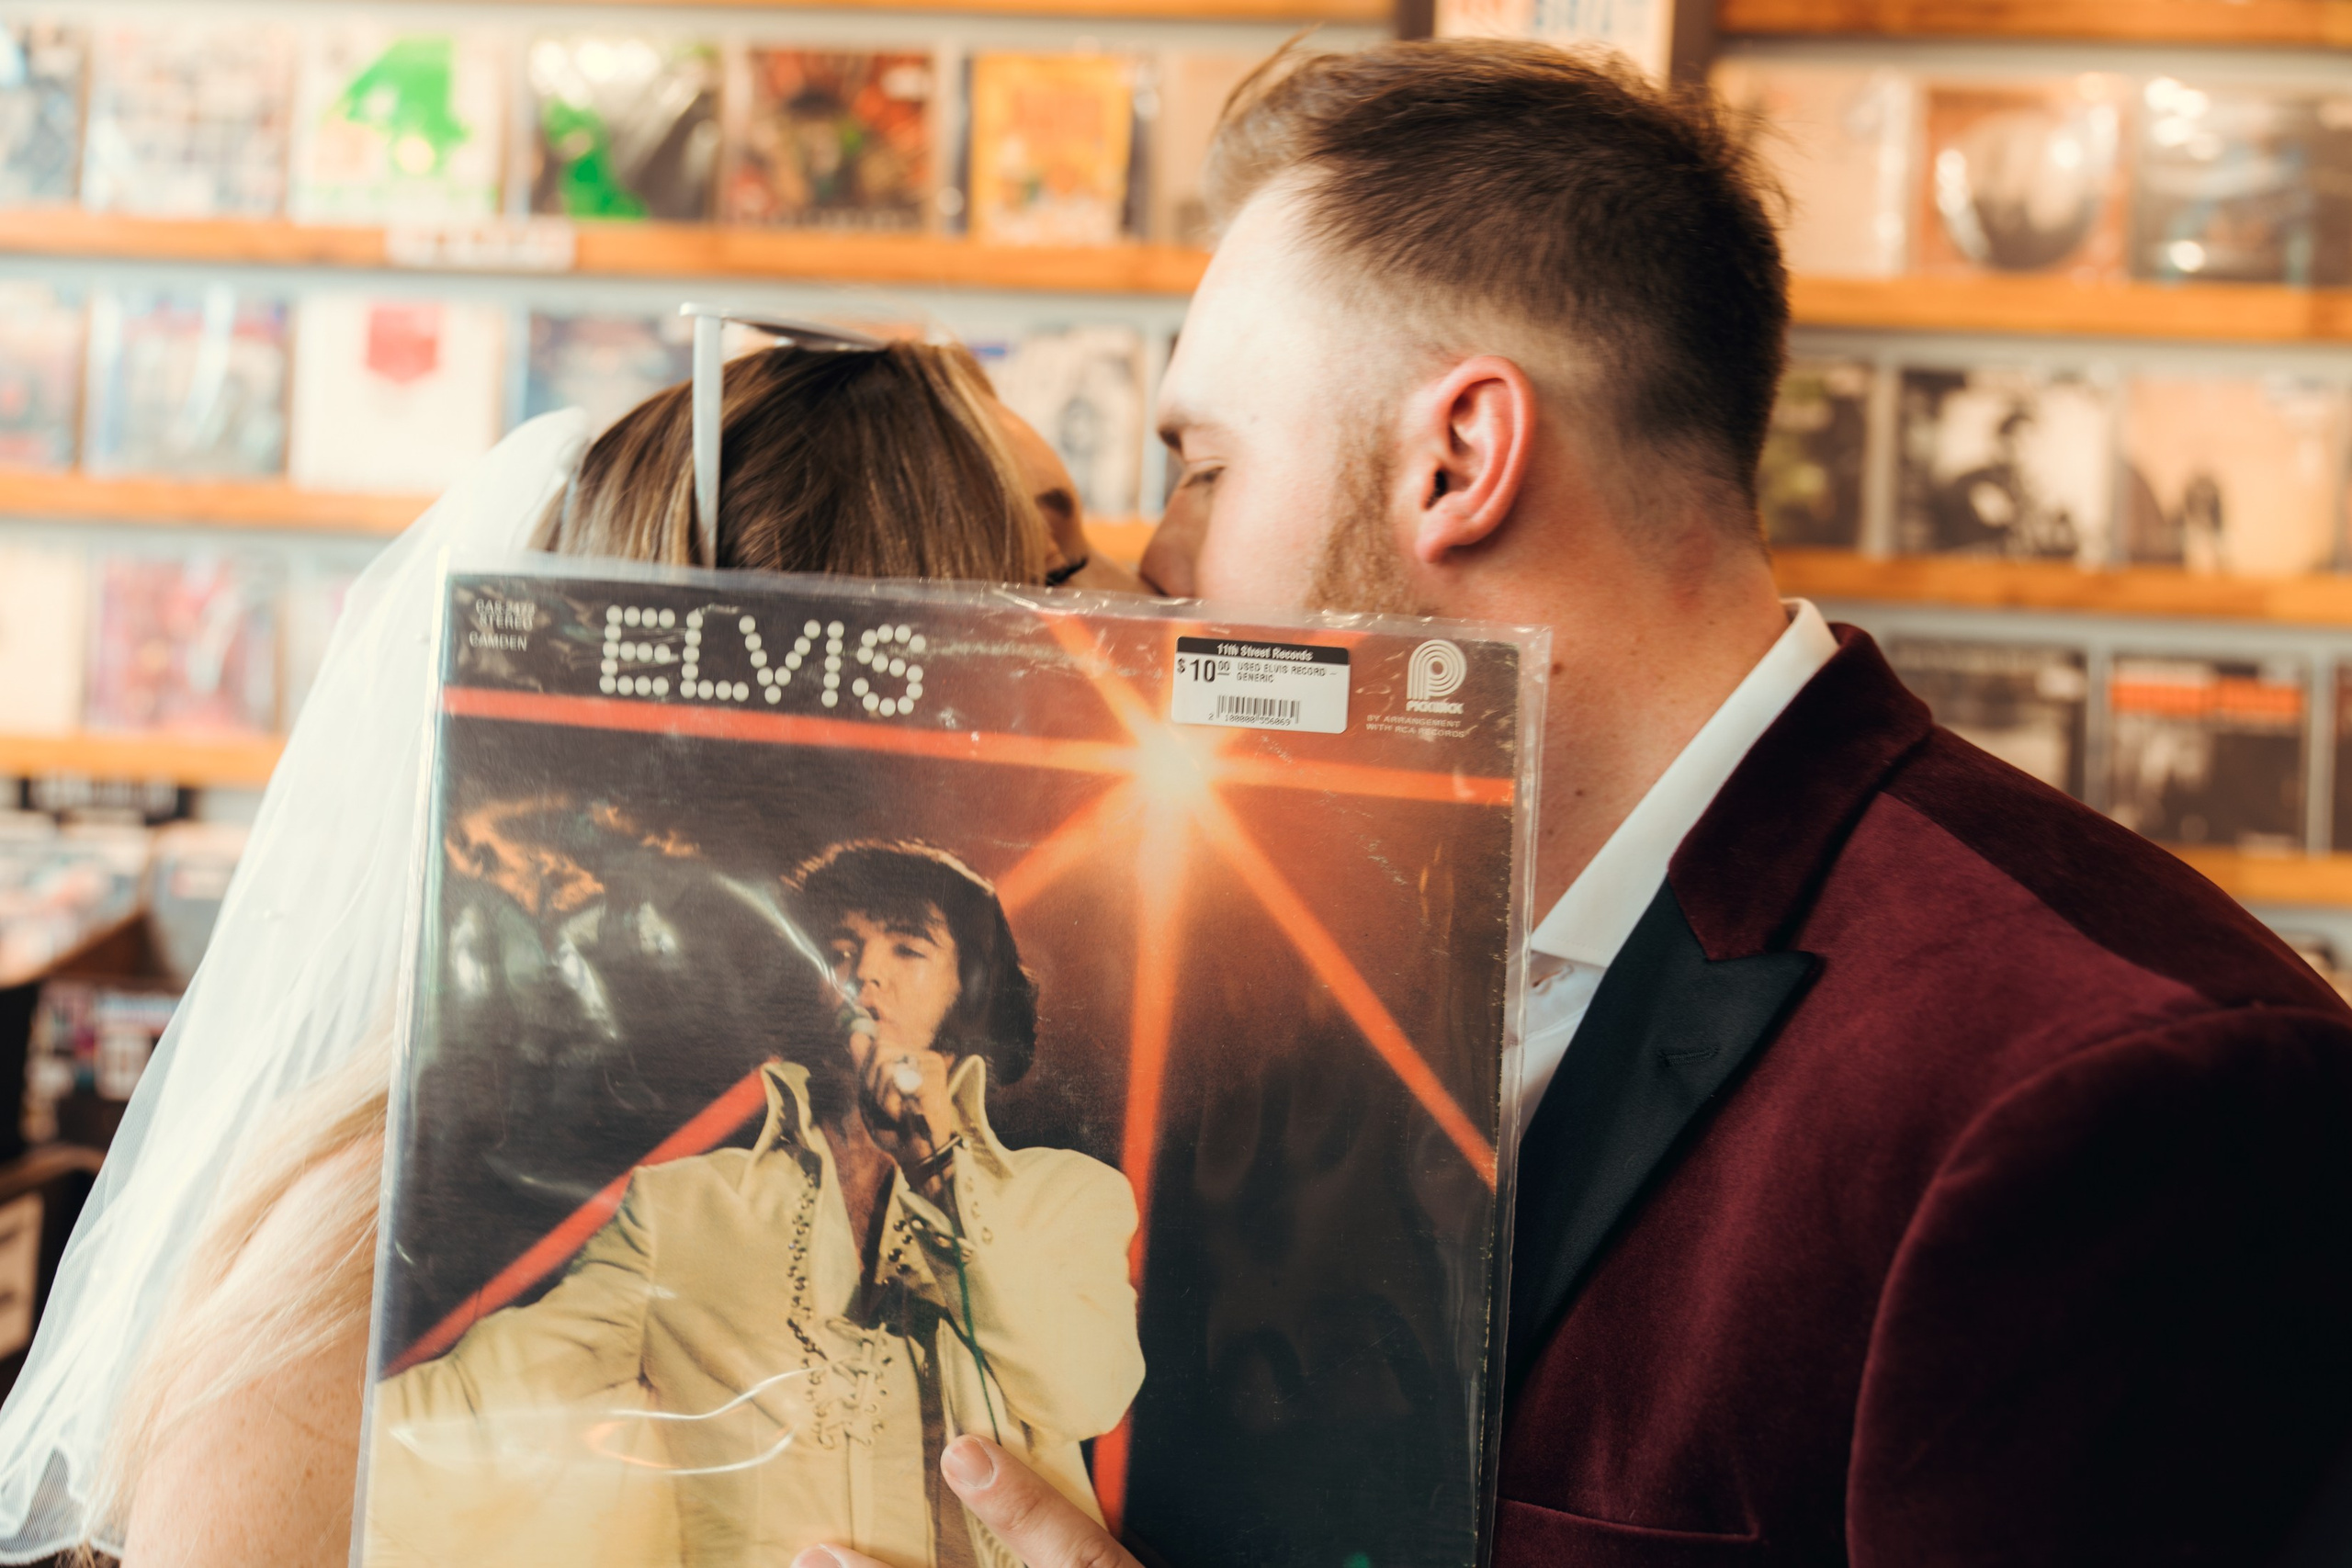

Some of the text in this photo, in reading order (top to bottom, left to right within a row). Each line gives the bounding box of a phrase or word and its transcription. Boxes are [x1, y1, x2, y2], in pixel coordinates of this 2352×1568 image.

[479, 613, 533, 632] STEREO
[469, 630, 527, 651] CAMDEN
[599, 604, 926, 716] ELVIS
[1217, 643, 1314, 661] 11th Street Records
[1236, 671, 1274, 682] GENERIC
[1238, 661, 1261, 672] USED
[1263, 663, 1288, 674] ELVIS
[1291, 666, 1326, 677] RECORD
[1366, 714, 1461, 728] BY ARRANGEMENT
[1365, 723, 1465, 739] WITH RCA RECORDS
